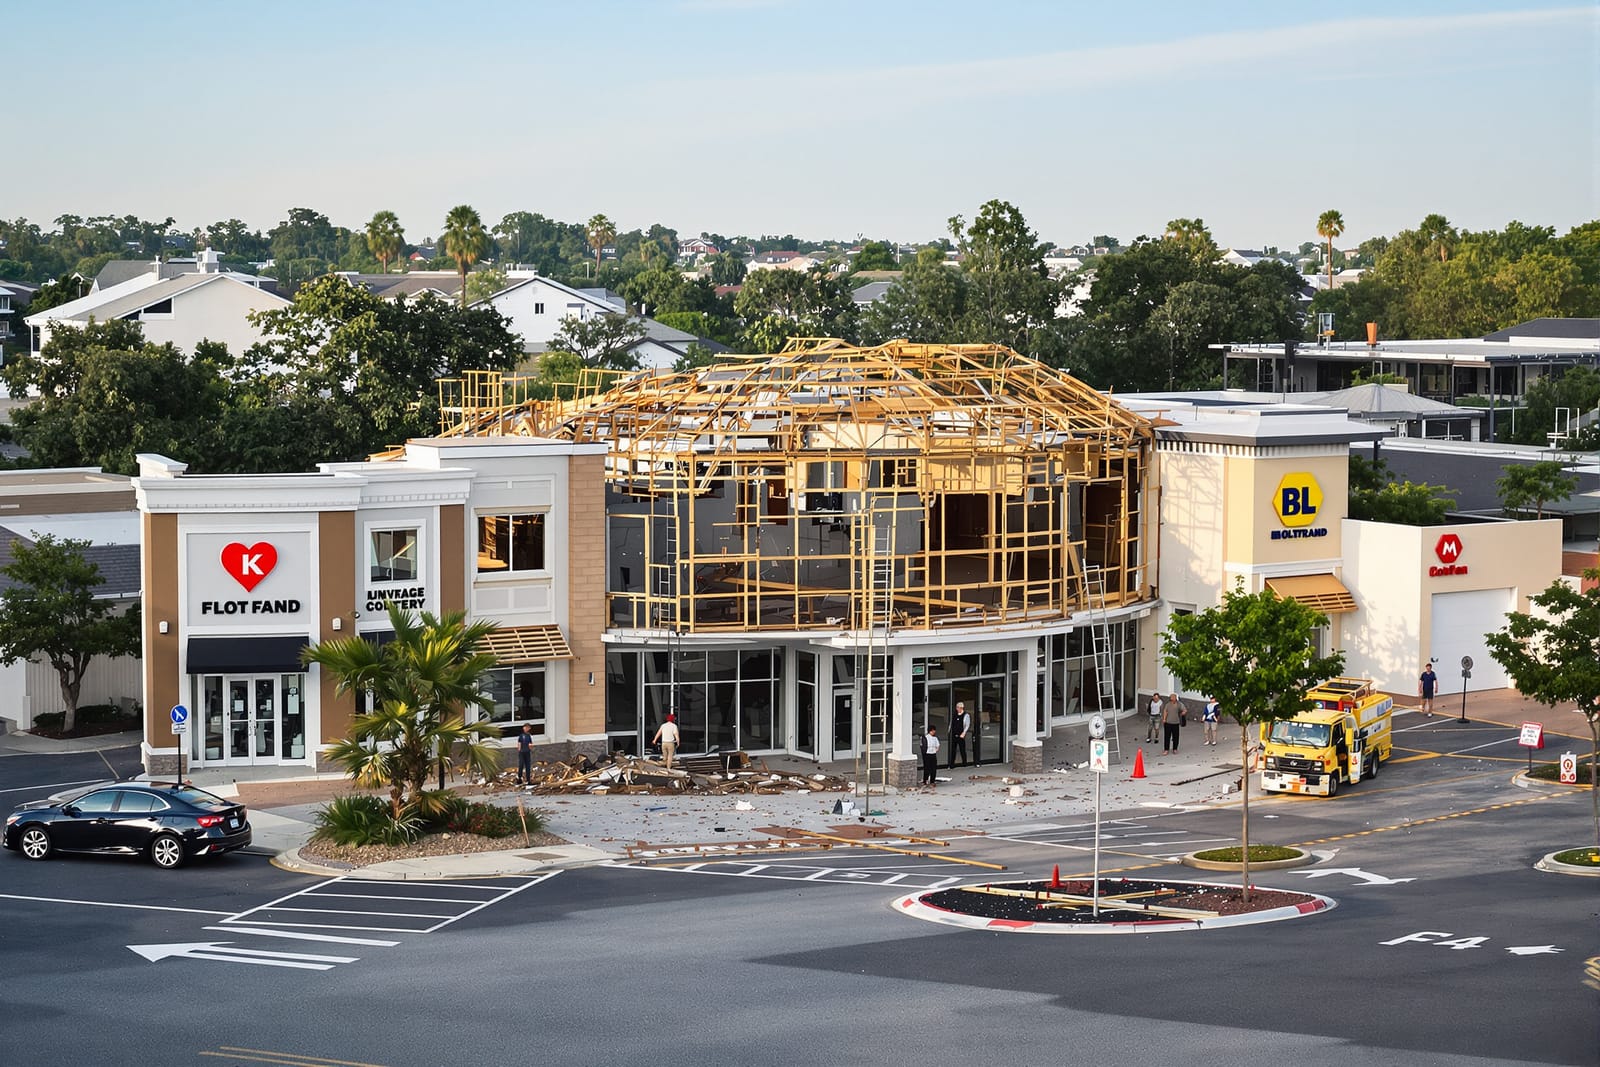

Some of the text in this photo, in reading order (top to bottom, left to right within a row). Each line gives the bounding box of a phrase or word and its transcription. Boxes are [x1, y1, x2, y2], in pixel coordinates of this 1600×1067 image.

[1282, 486, 1316, 516] BL
[1442, 541, 1458, 557] M
[241, 553, 265, 576] K
[202, 600, 301, 615] FLOT FAND
